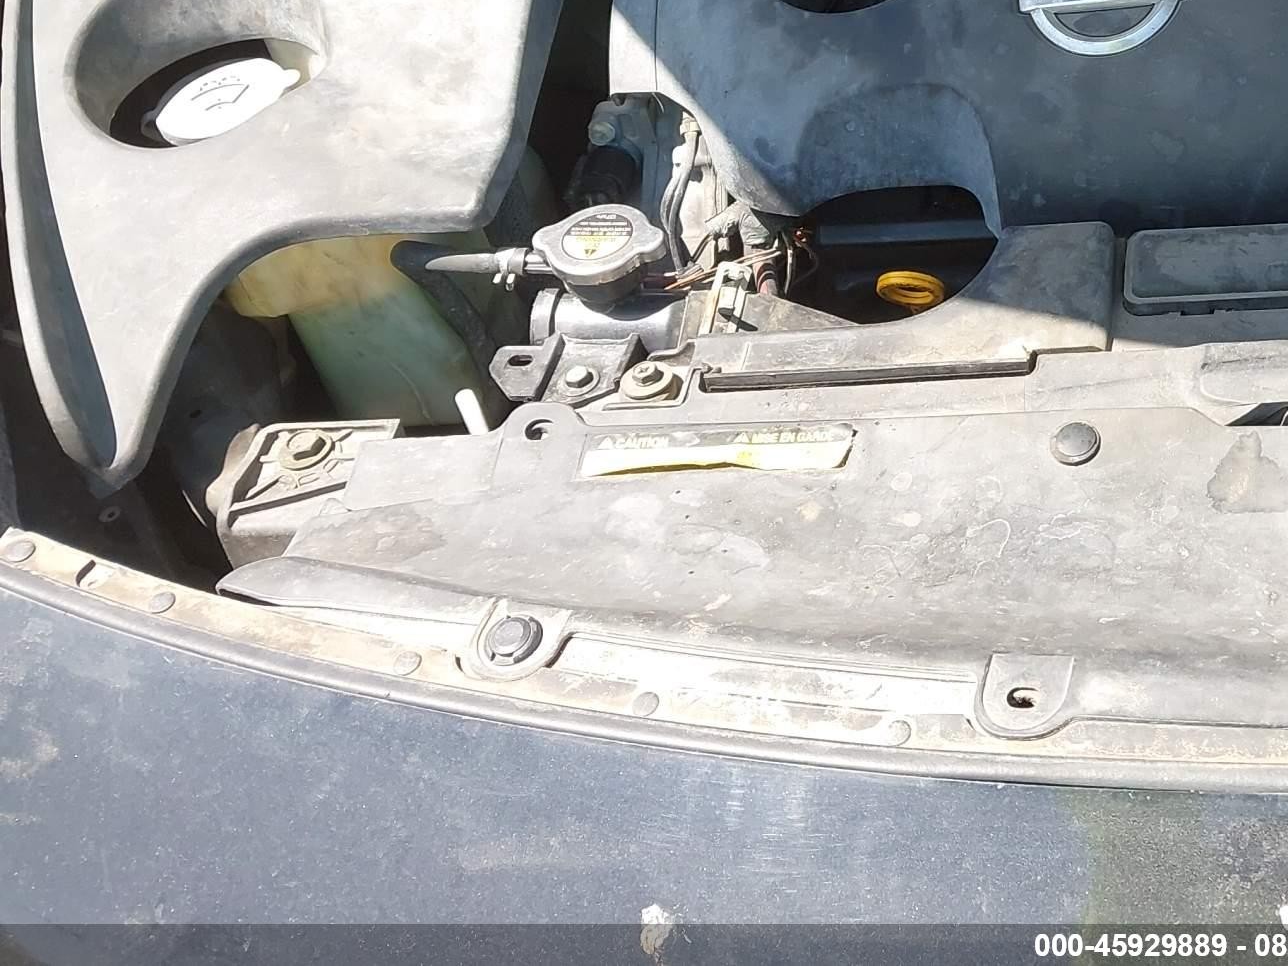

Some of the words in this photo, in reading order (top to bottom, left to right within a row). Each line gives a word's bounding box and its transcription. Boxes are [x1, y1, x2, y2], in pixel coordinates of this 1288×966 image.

[615, 435, 670, 450] CAUTION
[752, 432, 780, 444] MISE
[780, 431, 797, 443] EN
[797, 429, 835, 443] GARDE
